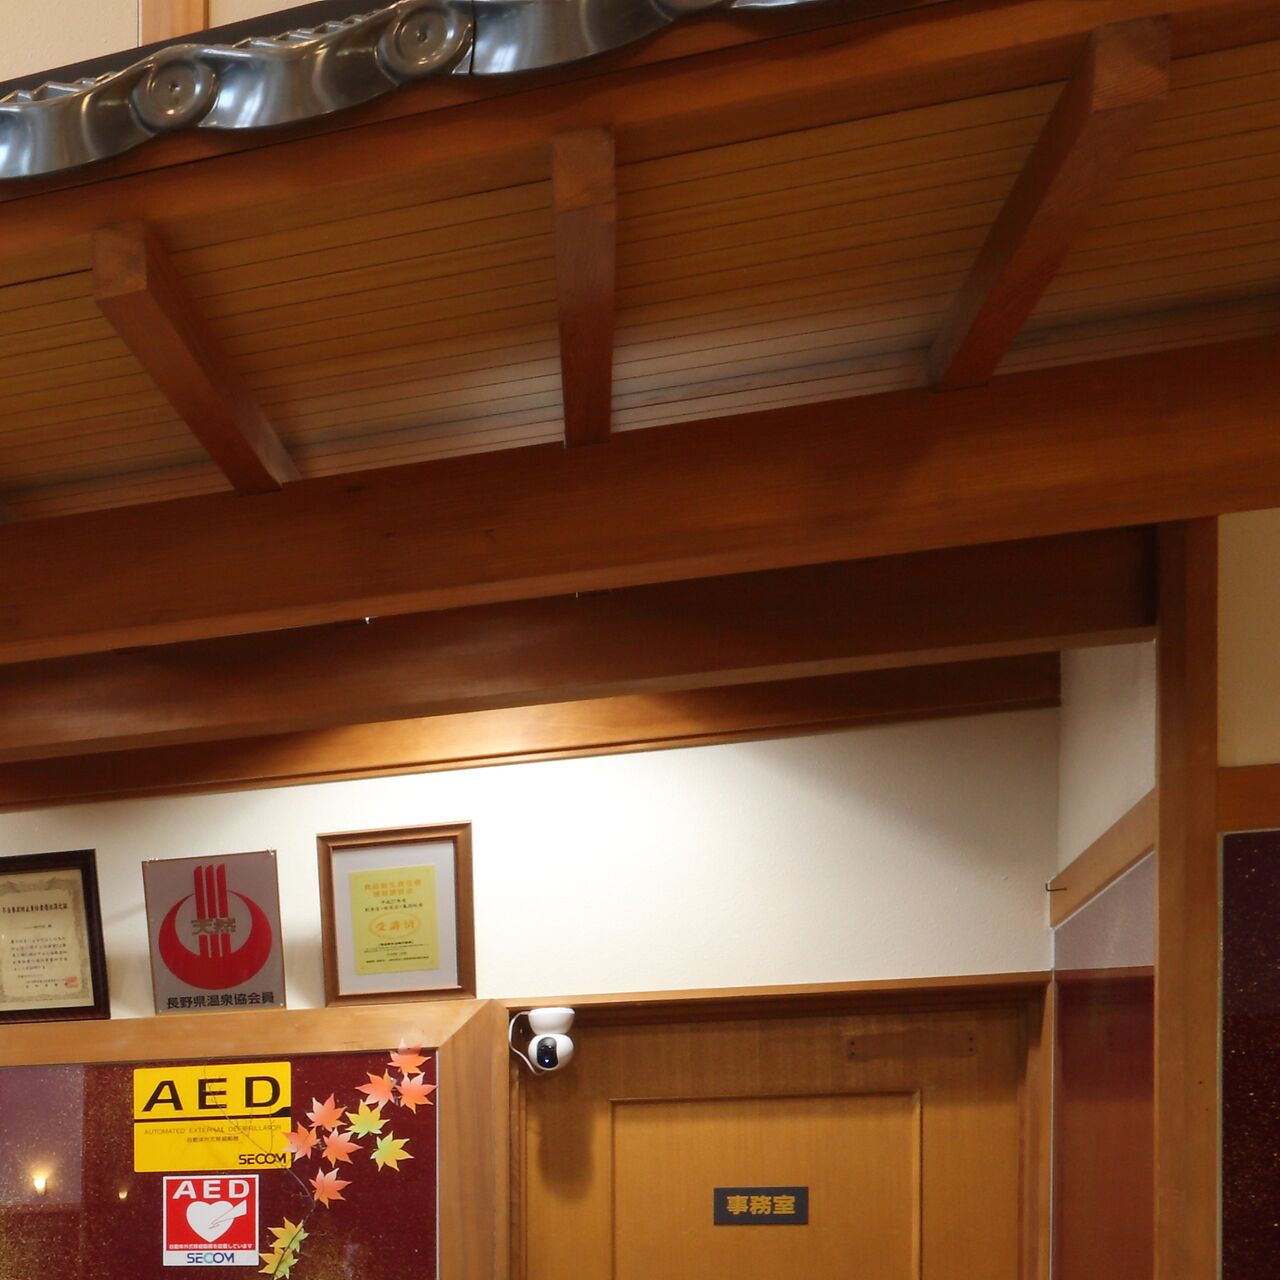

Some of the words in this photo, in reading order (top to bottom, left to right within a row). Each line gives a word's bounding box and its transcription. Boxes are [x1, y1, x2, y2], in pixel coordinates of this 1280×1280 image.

[191, 918, 236, 935] 天然
[167, 992, 274, 1009] 長野県温泉協会員
[142, 1076, 281, 1113] AED
[144, 1127, 186, 1135] AUTOMATED
[238, 1153, 287, 1165] SECOM
[172, 1180, 250, 1199] AED
[726, 1194, 795, 1215] 事務室
[187, 1252, 234, 1263] SECOM
